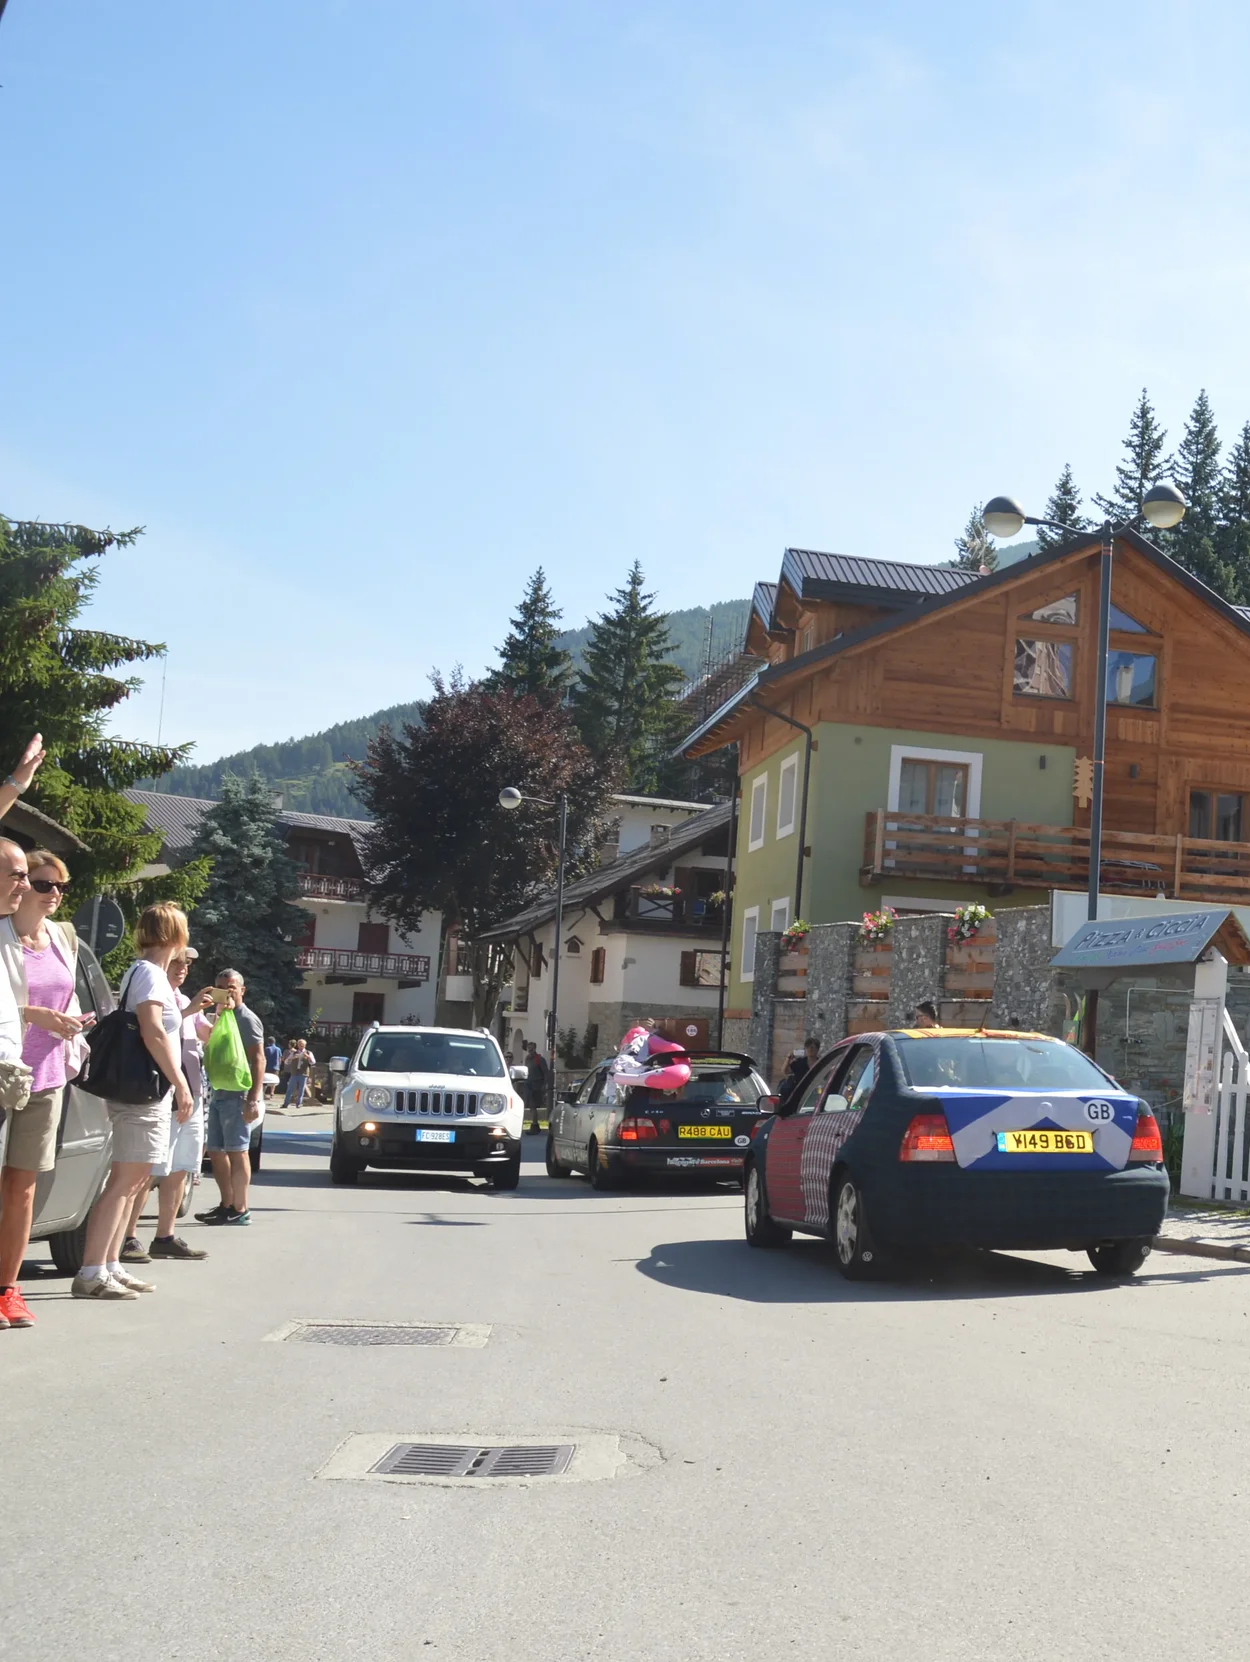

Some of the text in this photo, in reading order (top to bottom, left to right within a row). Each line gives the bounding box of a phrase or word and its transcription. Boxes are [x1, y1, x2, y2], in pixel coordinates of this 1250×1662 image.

[1087, 1103, 1110, 1120] GB
[679, 1127, 730, 1137] R488 CAU
